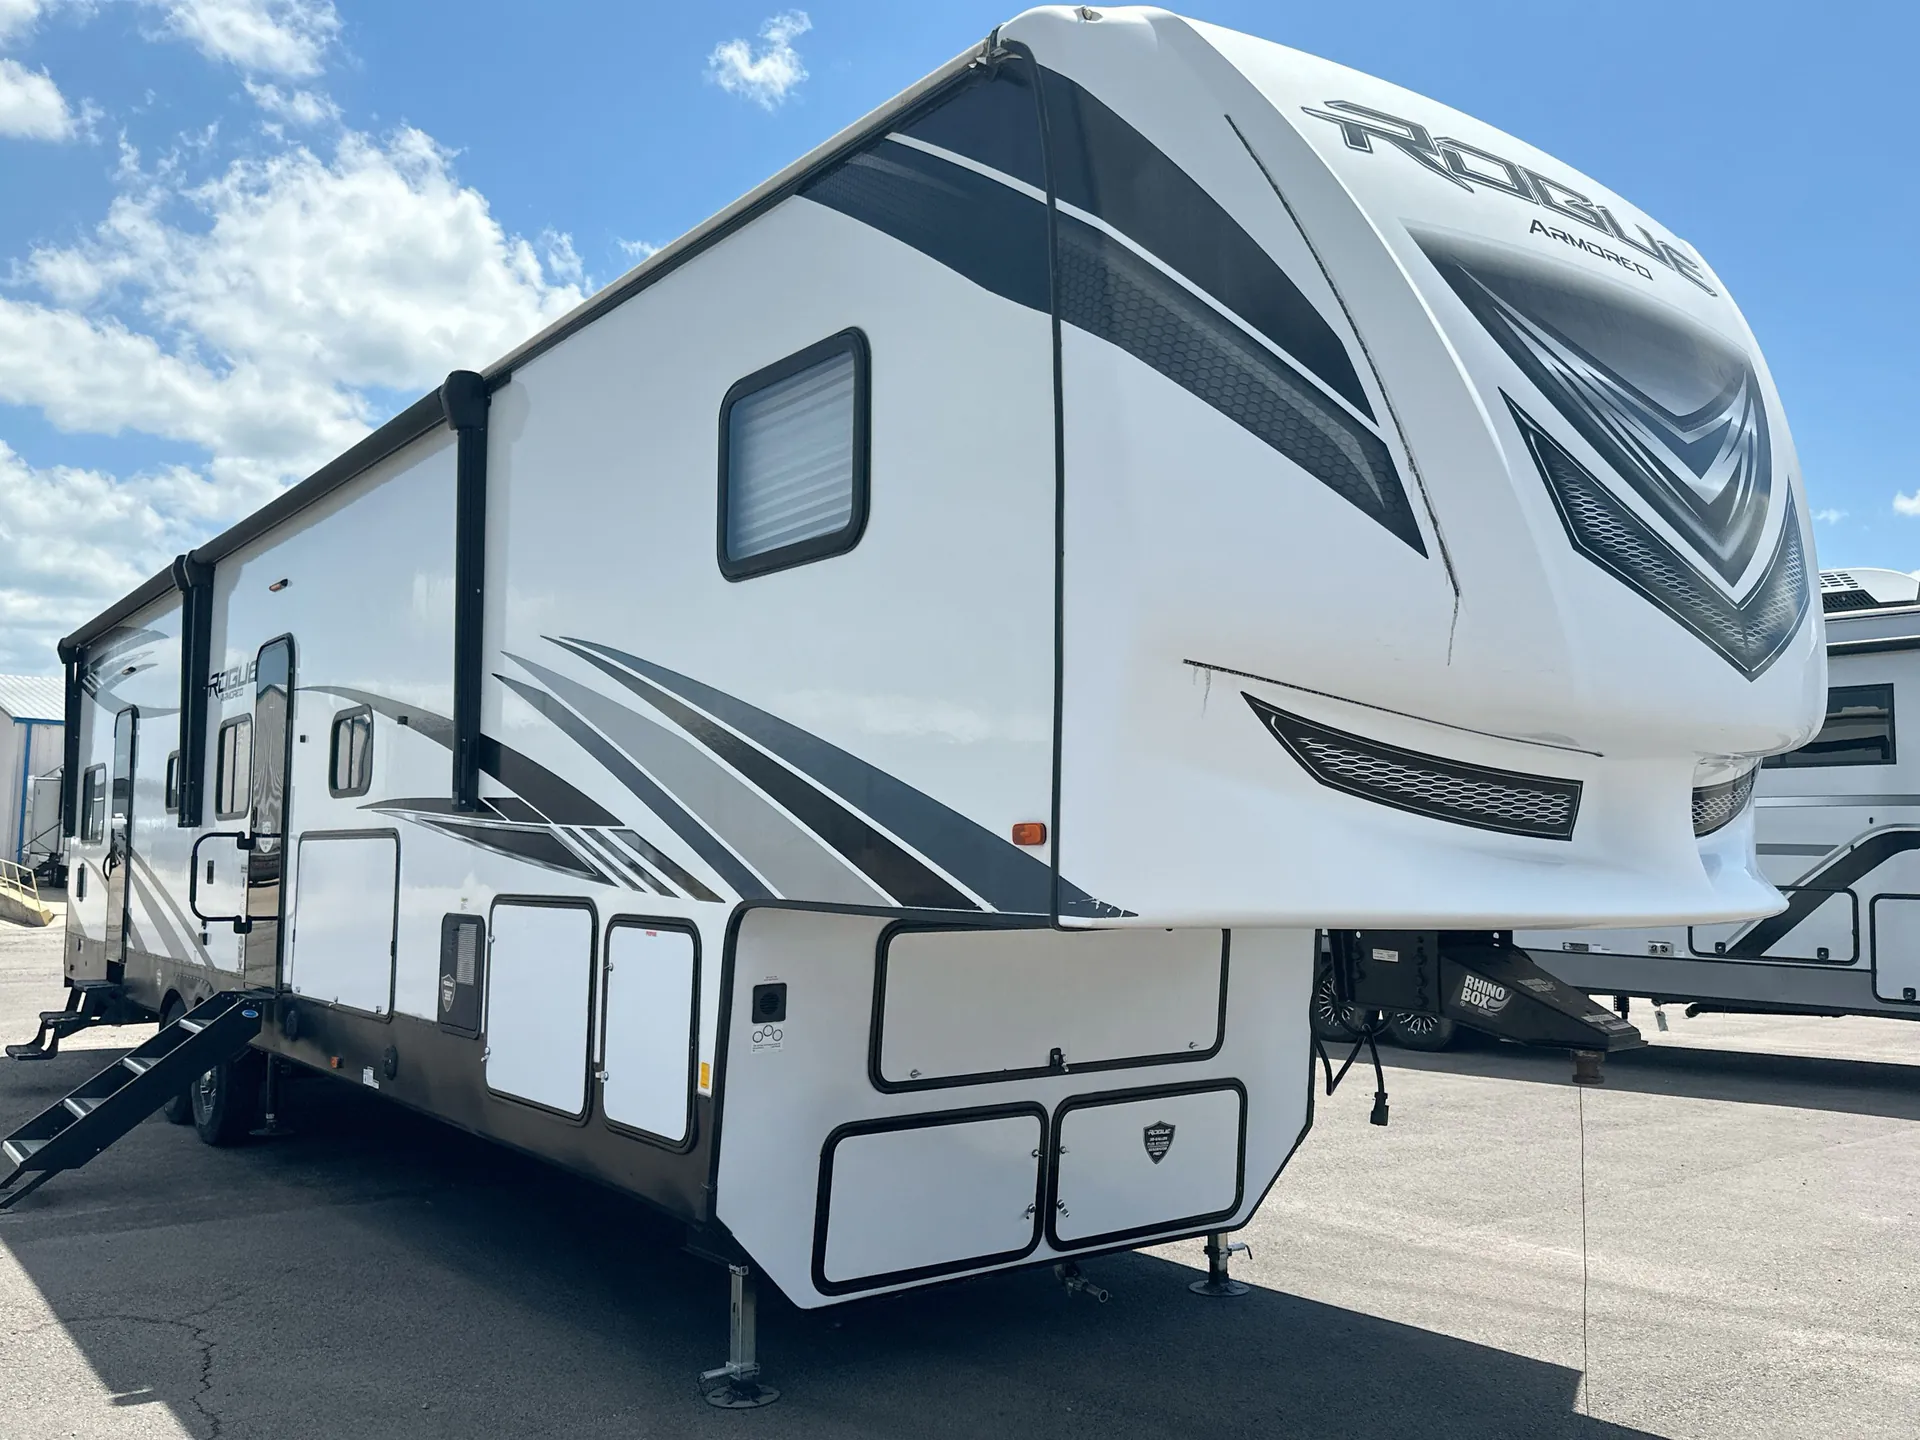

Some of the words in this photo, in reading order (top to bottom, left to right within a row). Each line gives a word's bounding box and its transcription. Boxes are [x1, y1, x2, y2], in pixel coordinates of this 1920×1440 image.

[1300, 100, 1718, 297] ROGUE
[1529, 219, 1654, 281] ARMORED
[205, 660, 257, 699] ROGUE
[1461, 987, 1490, 1009] BOX
[1464, 975, 1505, 1000] RHINO
